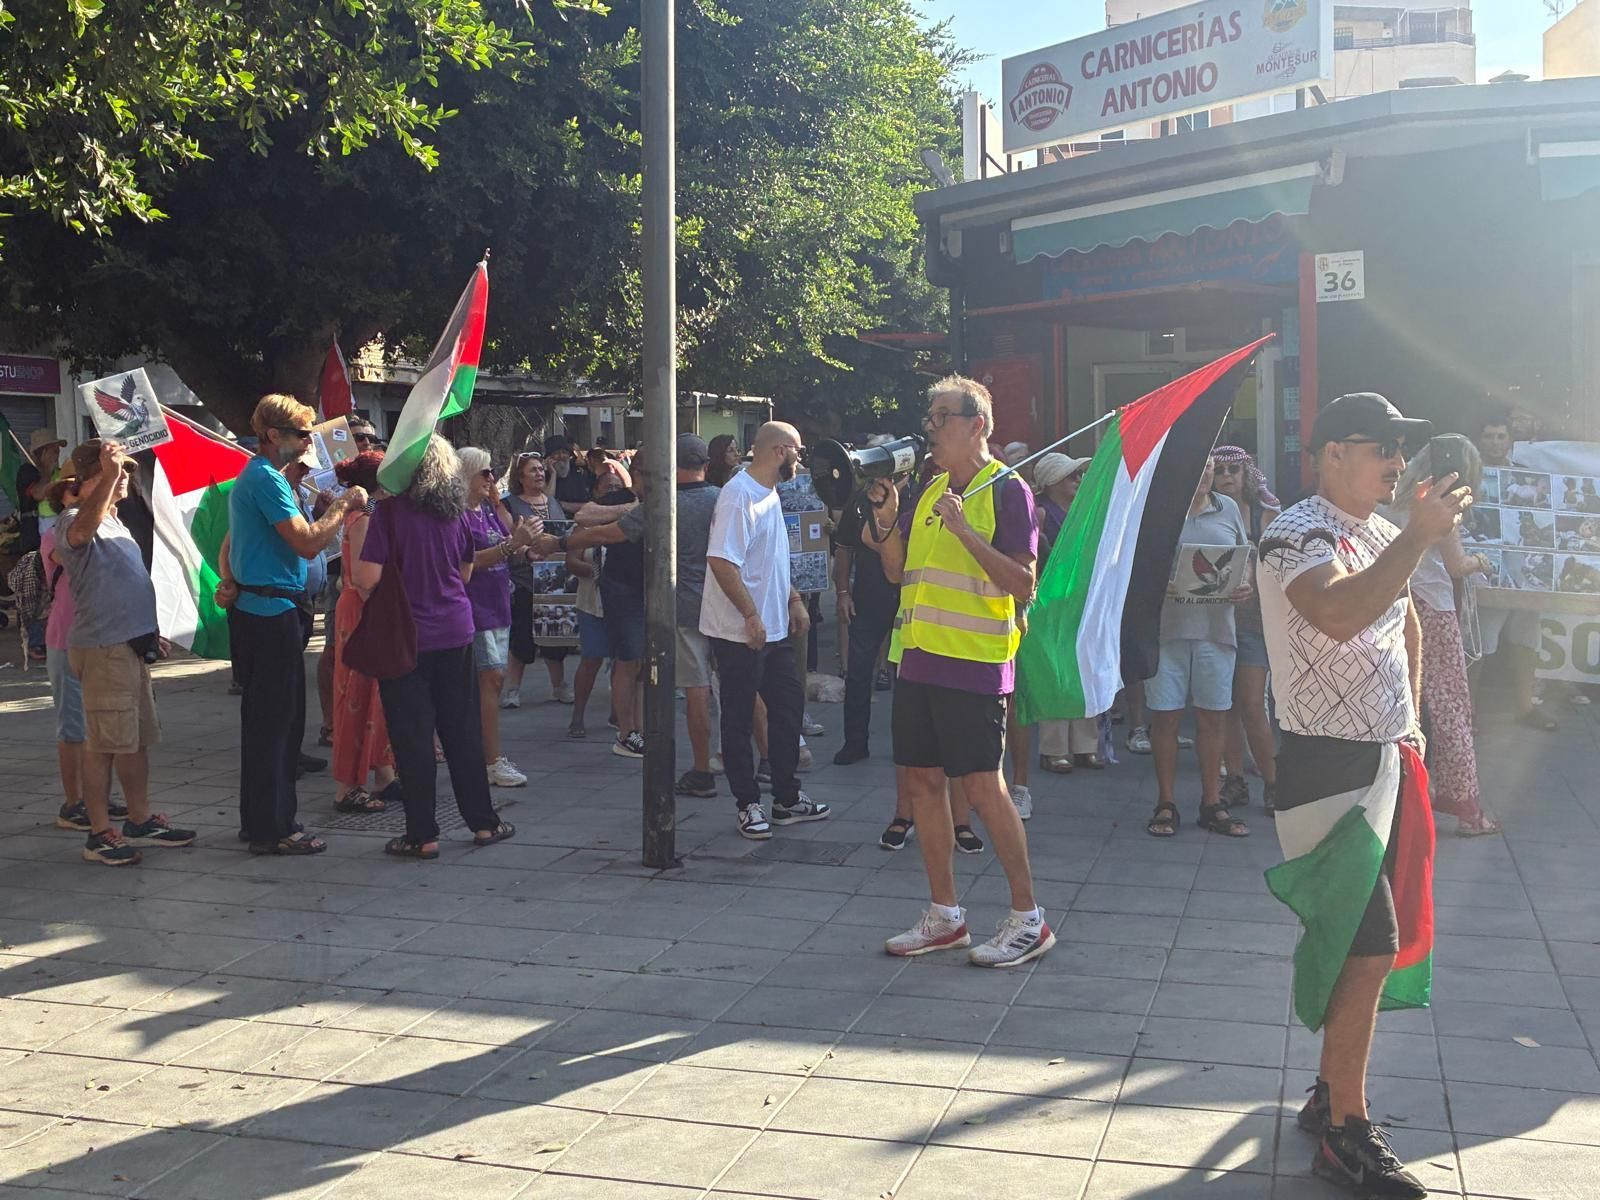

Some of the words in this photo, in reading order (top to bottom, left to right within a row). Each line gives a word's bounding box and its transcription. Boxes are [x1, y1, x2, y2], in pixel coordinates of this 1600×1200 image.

[1081, 10, 1242, 79] CARNICERÍAS
[1256, 50, 1317, 75] MONTESUR
[1018, 87, 1065, 116] ANTONIO
[1101, 62, 1219, 117] ANTONIO
[1323, 270, 1356, 292] 36
[129, 428, 169, 448] GENOCIDIO
